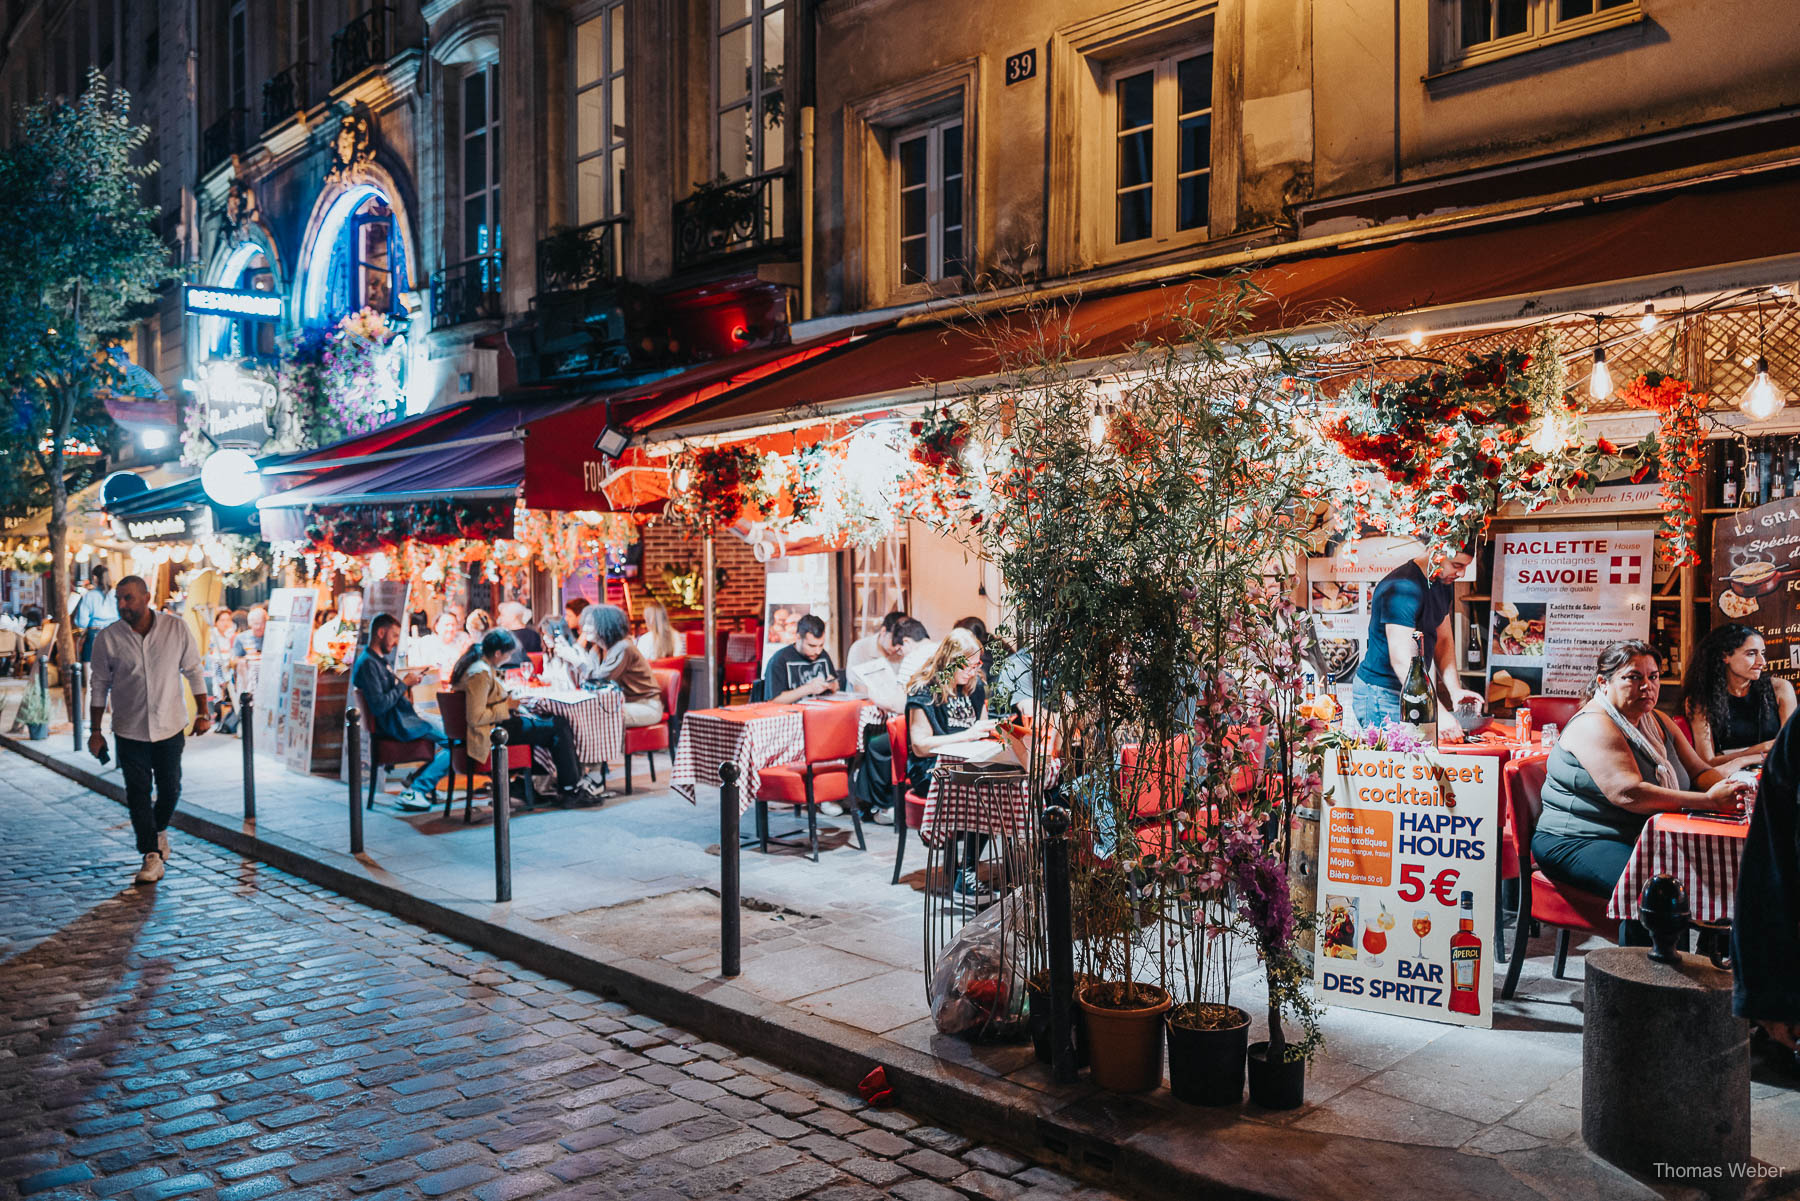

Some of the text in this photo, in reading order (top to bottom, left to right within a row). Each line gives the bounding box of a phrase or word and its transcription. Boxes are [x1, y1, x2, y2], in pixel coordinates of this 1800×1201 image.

[1010, 54, 1032, 80] 39
[1562, 494, 1617, 508] Savoyarde
[1760, 508, 1800, 527] GRA
[1503, 540, 1608, 555] RACLETTE
[1748, 534, 1800, 552] Spécia
[1521, 557, 1596, 566] des montagnes
[1518, 569, 1598, 584] SAVOIE
[1631, 603, 1646, 611] 16€
[1336, 755, 1484, 783] Exotic sweet
[1358, 783, 1457, 808] cocktails
[1331, 809, 1355, 821] Spritz
[1331, 824, 1375, 835] Cocktail de
[1399, 812, 1484, 837] HAPPY
[1330, 835, 1388, 848] fruits exotiques
[1398, 835, 1486, 861] HOURS
[1330, 857, 1355, 868] Mojito
[1329, 869, 1350, 880] Bière
[1397, 863, 1461, 907] 5€
[1452, 949, 1479, 959] APEROL
[1397, 959, 1444, 984] BAR
[1322, 972, 1443, 1008] DES SPRITZ
